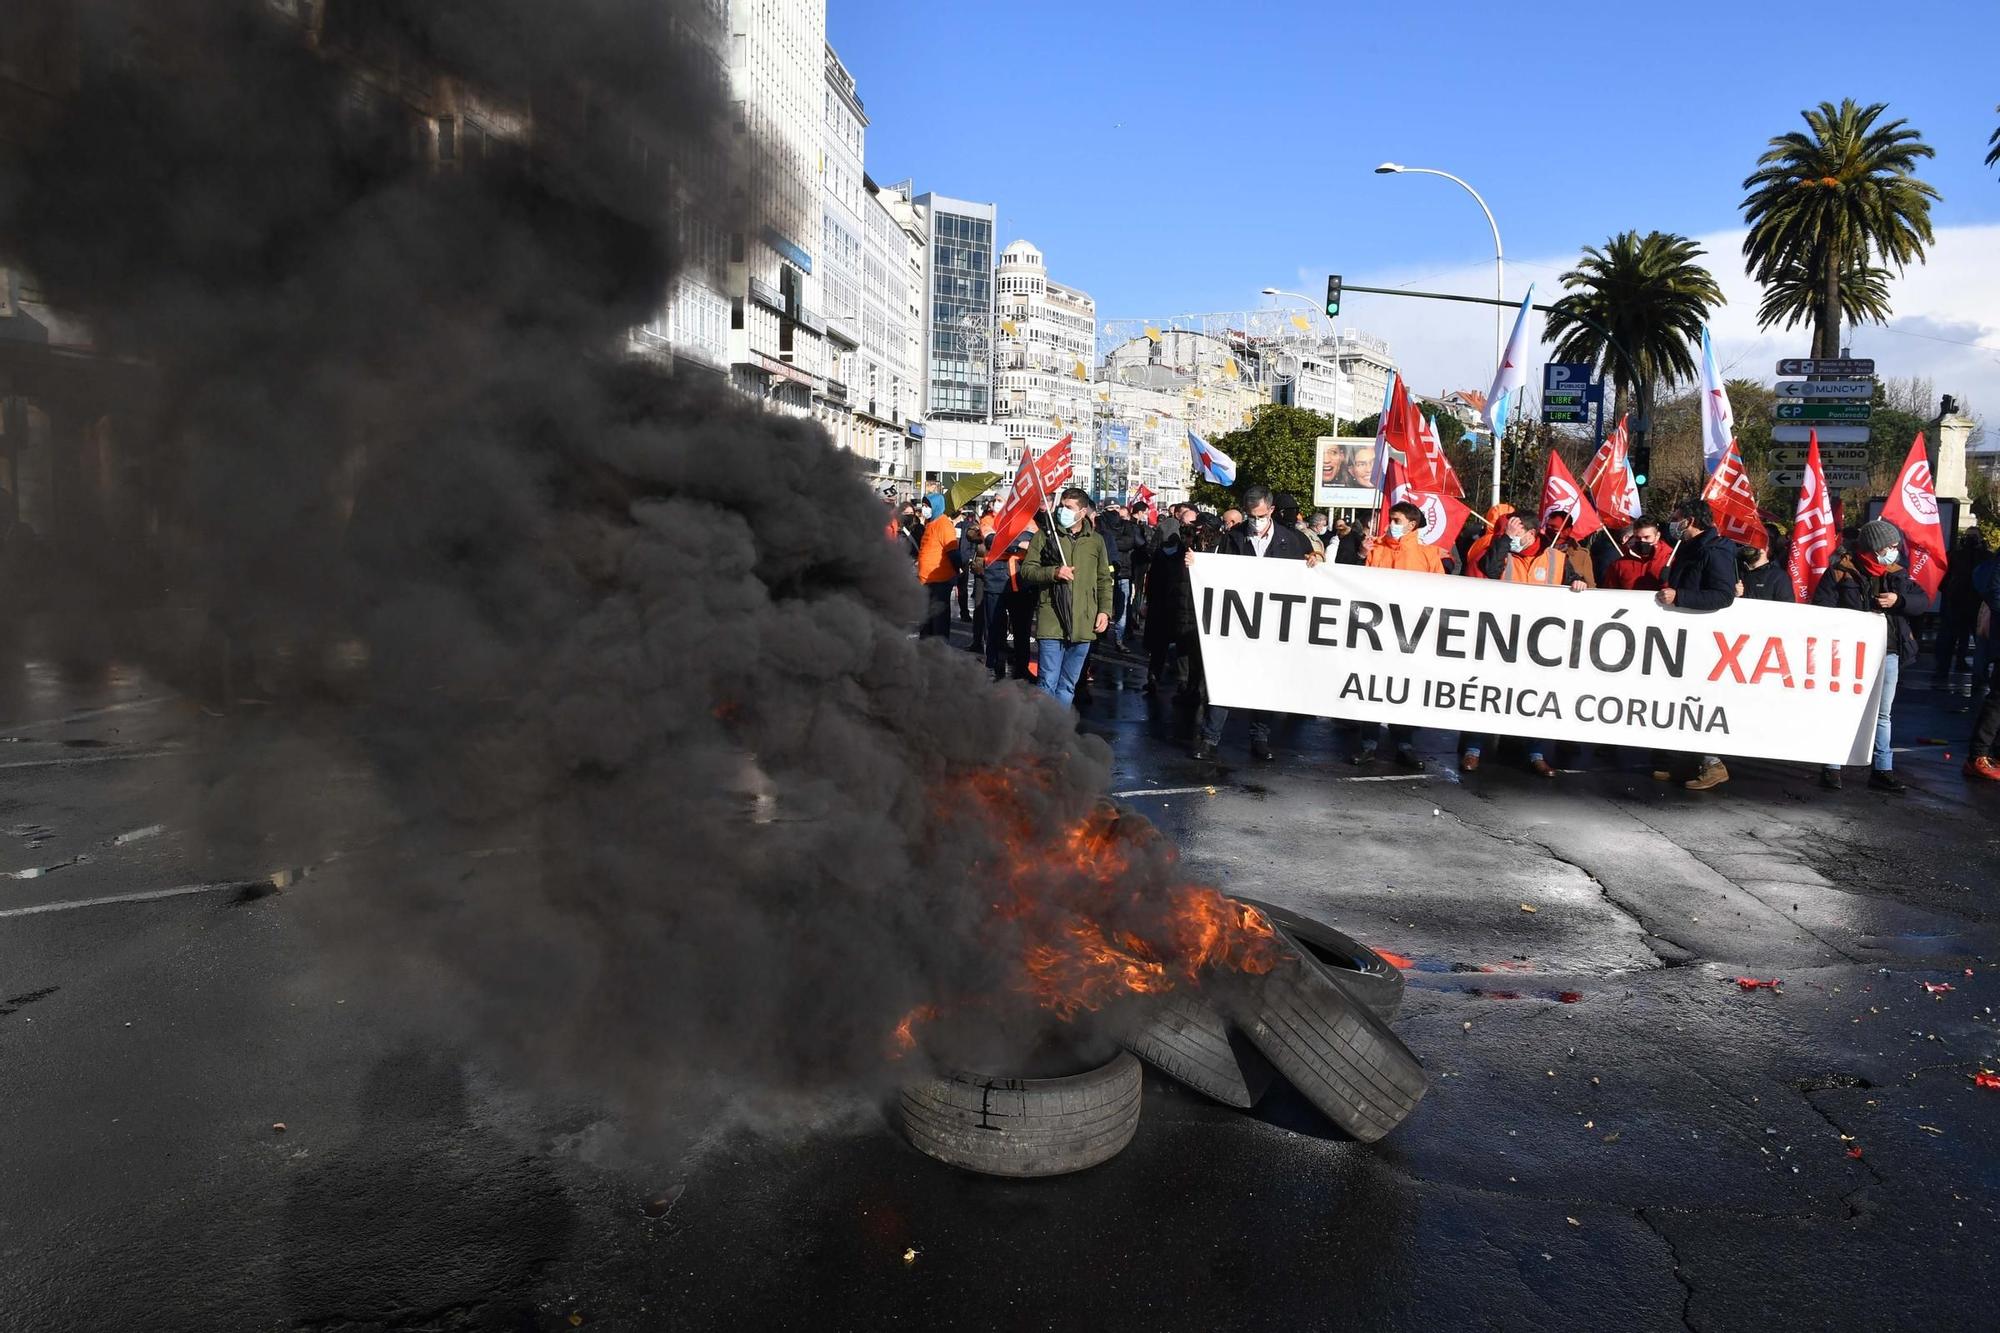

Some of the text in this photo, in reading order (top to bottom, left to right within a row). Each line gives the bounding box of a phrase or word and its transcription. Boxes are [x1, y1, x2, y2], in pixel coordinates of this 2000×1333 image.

[1550, 366, 1570, 389] P
[1815, 385, 1866, 393] MUNCYT
[1551, 396, 1572, 404] LIBRE
[1550, 412, 1571, 420] LIBRE
[1837, 450, 1865, 458] NIDO
[1202, 587, 1866, 694] INTERVENCIÓN XA!!!
[1339, 673, 1730, 735] ALU IBÉRICA CORUÑA
